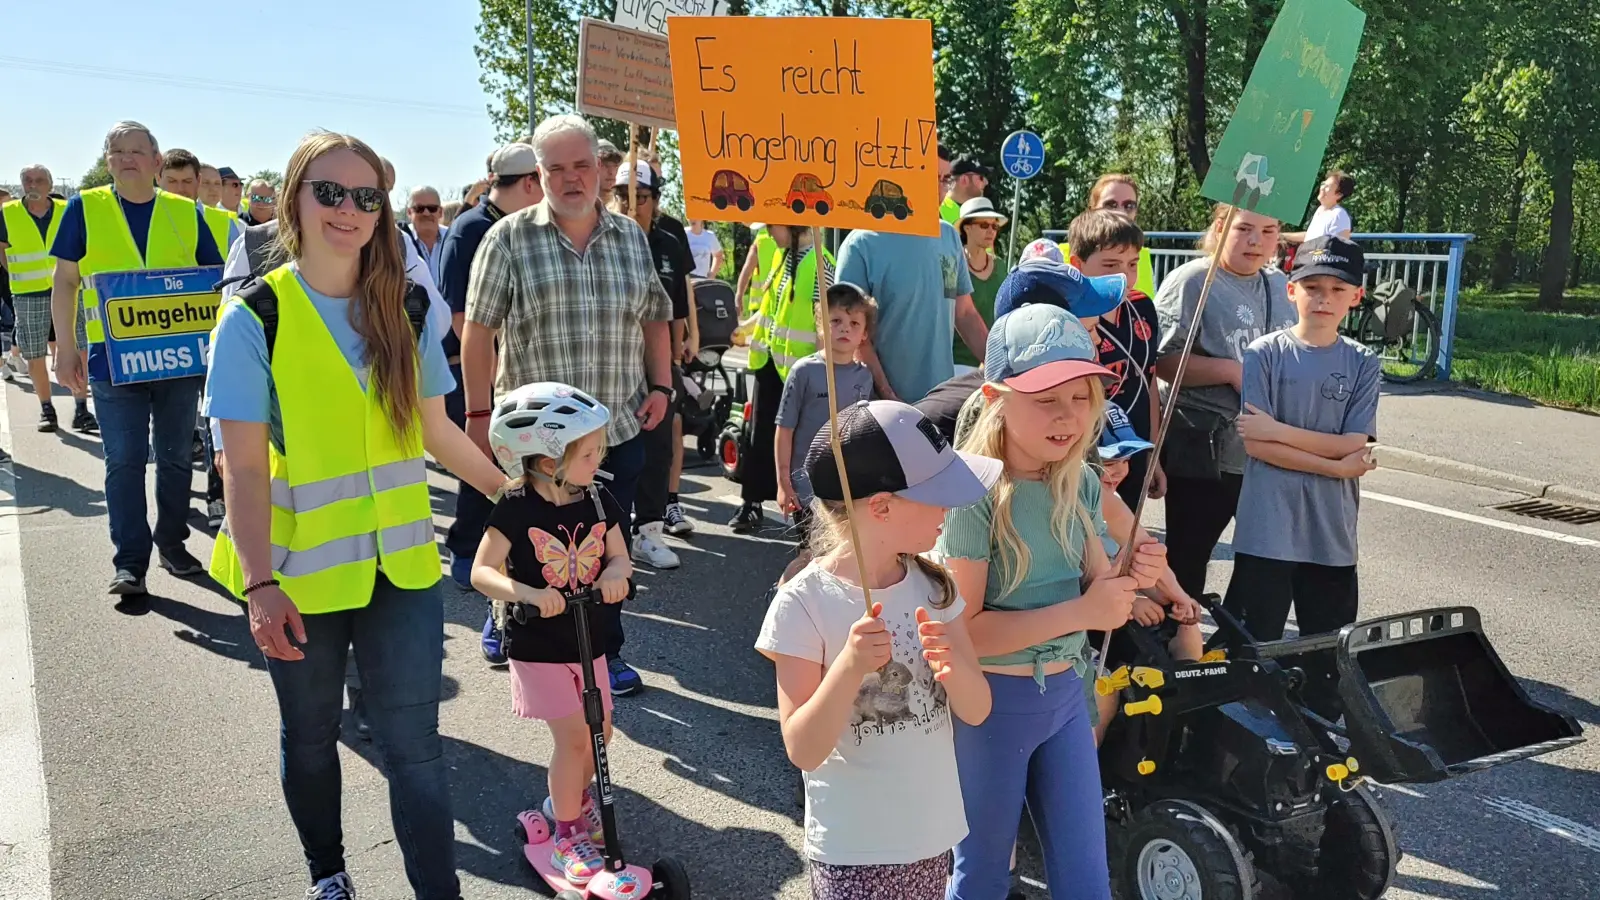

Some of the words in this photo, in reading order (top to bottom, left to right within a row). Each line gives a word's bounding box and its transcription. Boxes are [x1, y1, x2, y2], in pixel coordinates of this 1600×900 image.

[695, 37, 736, 93] Es
[781, 38, 865, 95] reicht
[701, 110, 837, 188] Umgehung
[844, 117, 935, 187] jetzt!
[163, 277, 184, 290] Die
[120, 345, 193, 375] muss
[1175, 667, 1227, 678] DEUTZ-FAHR
[598, 736, 610, 794] SAWYER
